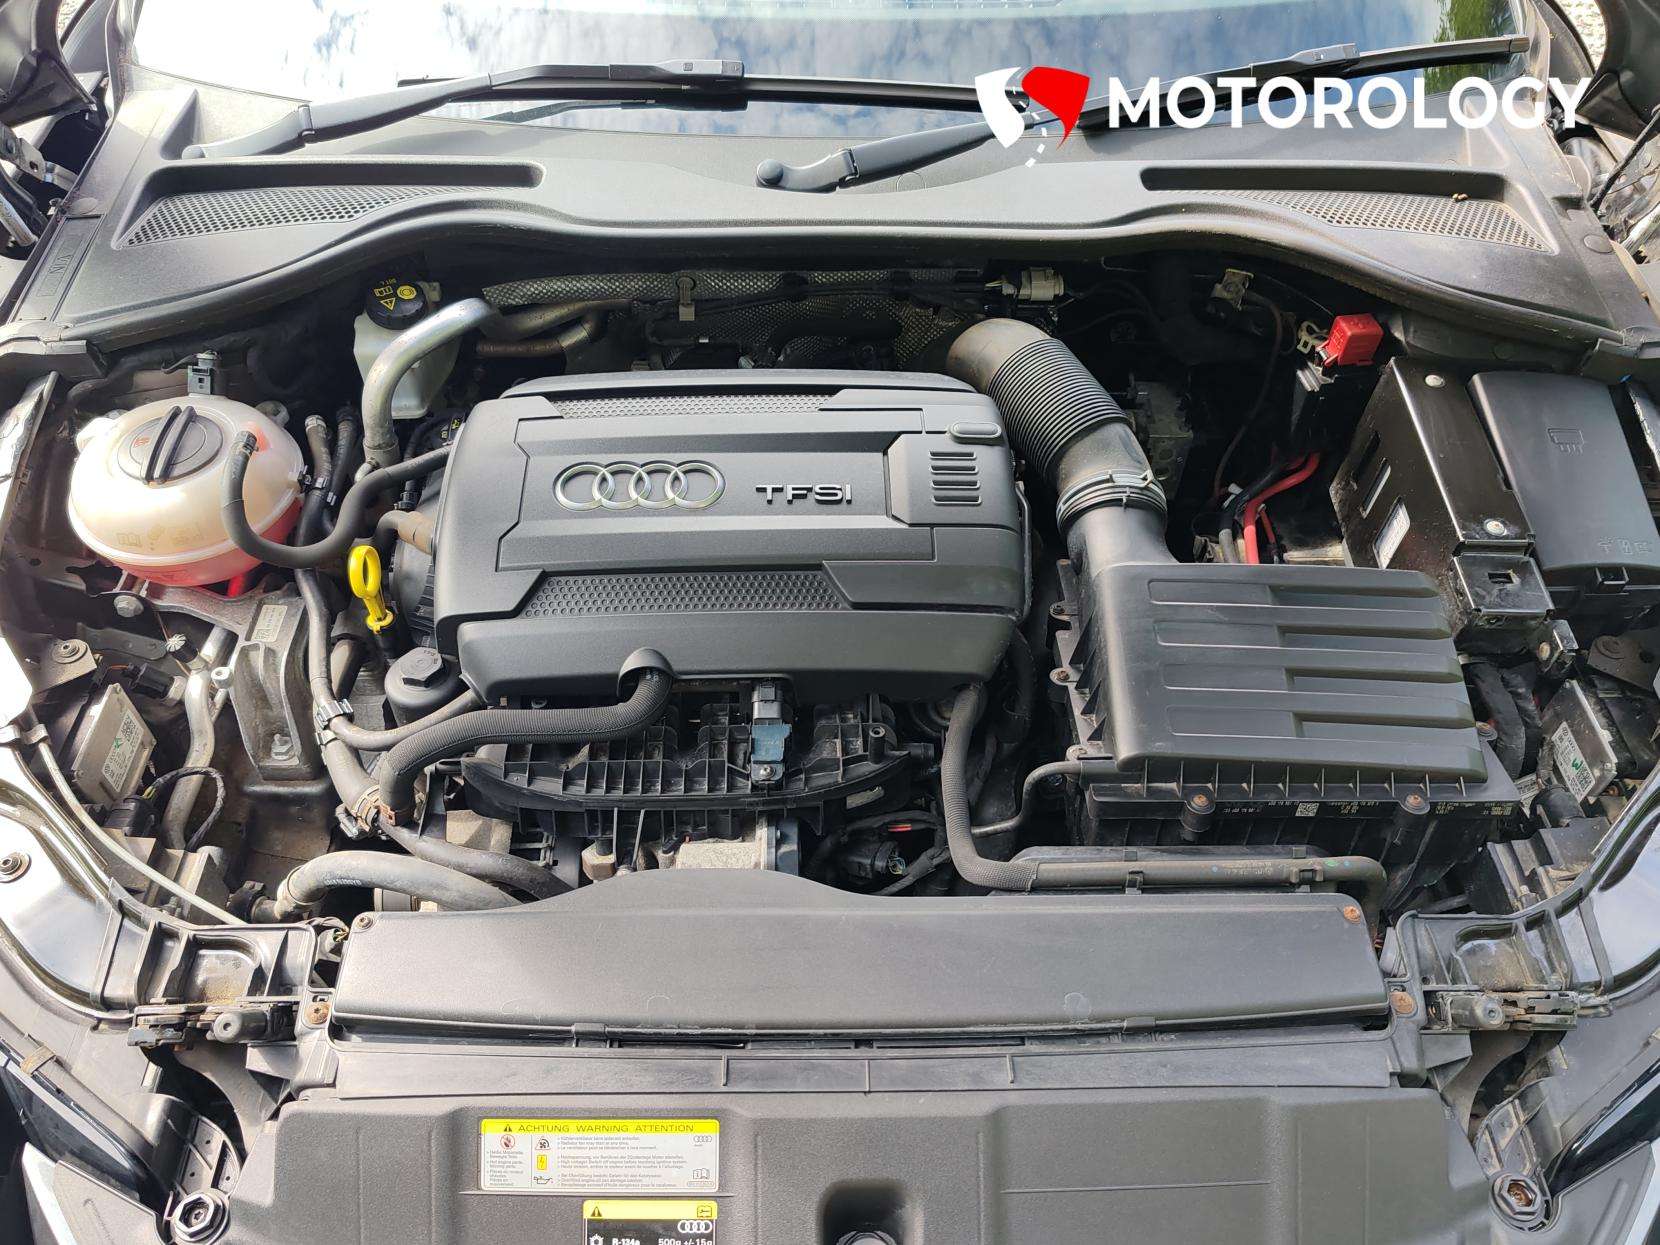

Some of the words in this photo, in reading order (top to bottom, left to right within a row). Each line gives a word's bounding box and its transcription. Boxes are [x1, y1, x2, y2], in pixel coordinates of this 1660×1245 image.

[756, 484, 853, 505] TFSI
[518, 1124, 569, 1133] ACHTUNG
[576, 1124, 629, 1133] WARNING
[635, 1124, 694, 1133] ATTENTION
